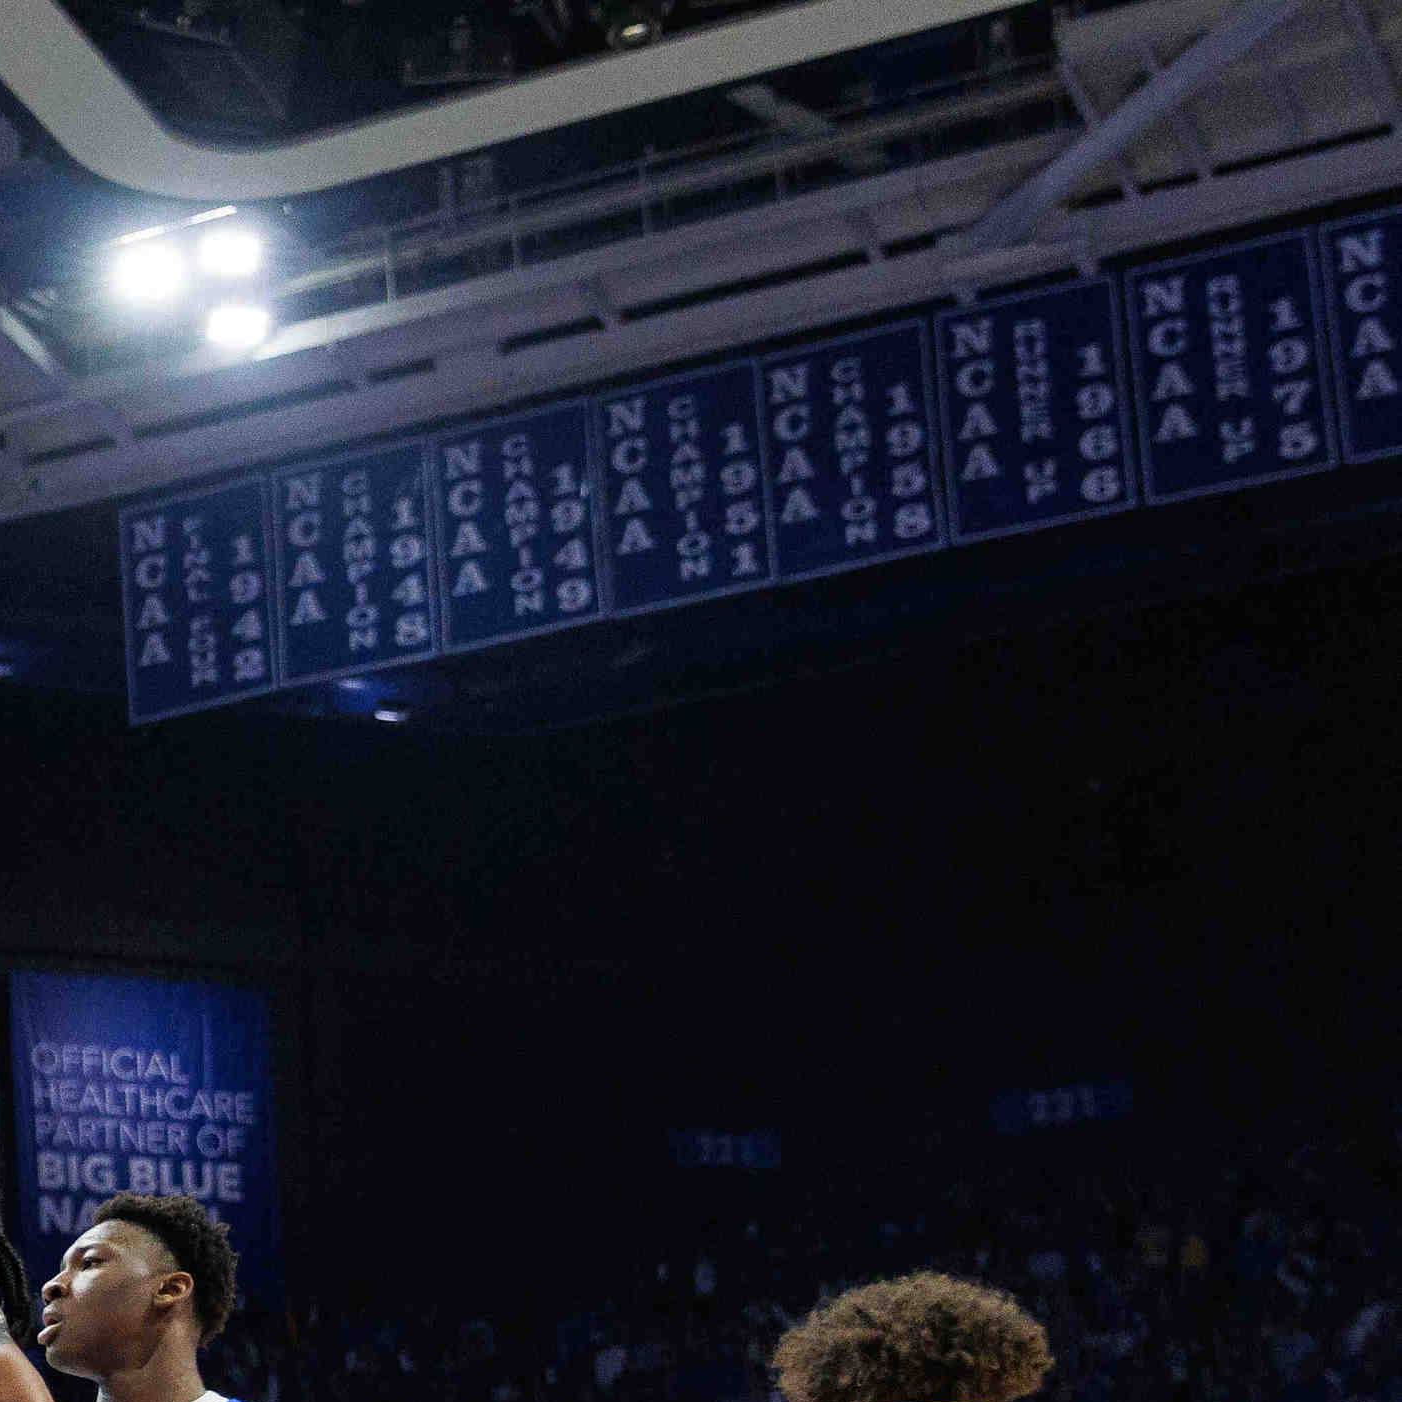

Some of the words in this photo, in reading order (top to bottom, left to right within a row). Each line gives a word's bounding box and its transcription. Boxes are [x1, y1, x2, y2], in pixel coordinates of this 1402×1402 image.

[950, 316, 1000, 484] NCAA
[1139, 273, 1197, 444] NCAA
[607, 399, 654, 556] NCAA
[768, 360, 821, 525] NCAA
[132, 518, 173, 667] NCAA
[287, 477, 328, 627] NCAA
[445, 441, 488, 599] NCAA
[30, 1041, 188, 1085] OFFICIAL
[33, 1080, 254, 1124] HEALTHCARE
[35, 1114, 189, 1155] PARTNER
[197, 1124, 246, 1158] OF
[36, 1151, 117, 1194] BIG
[128, 1157, 244, 1202] BLUE
